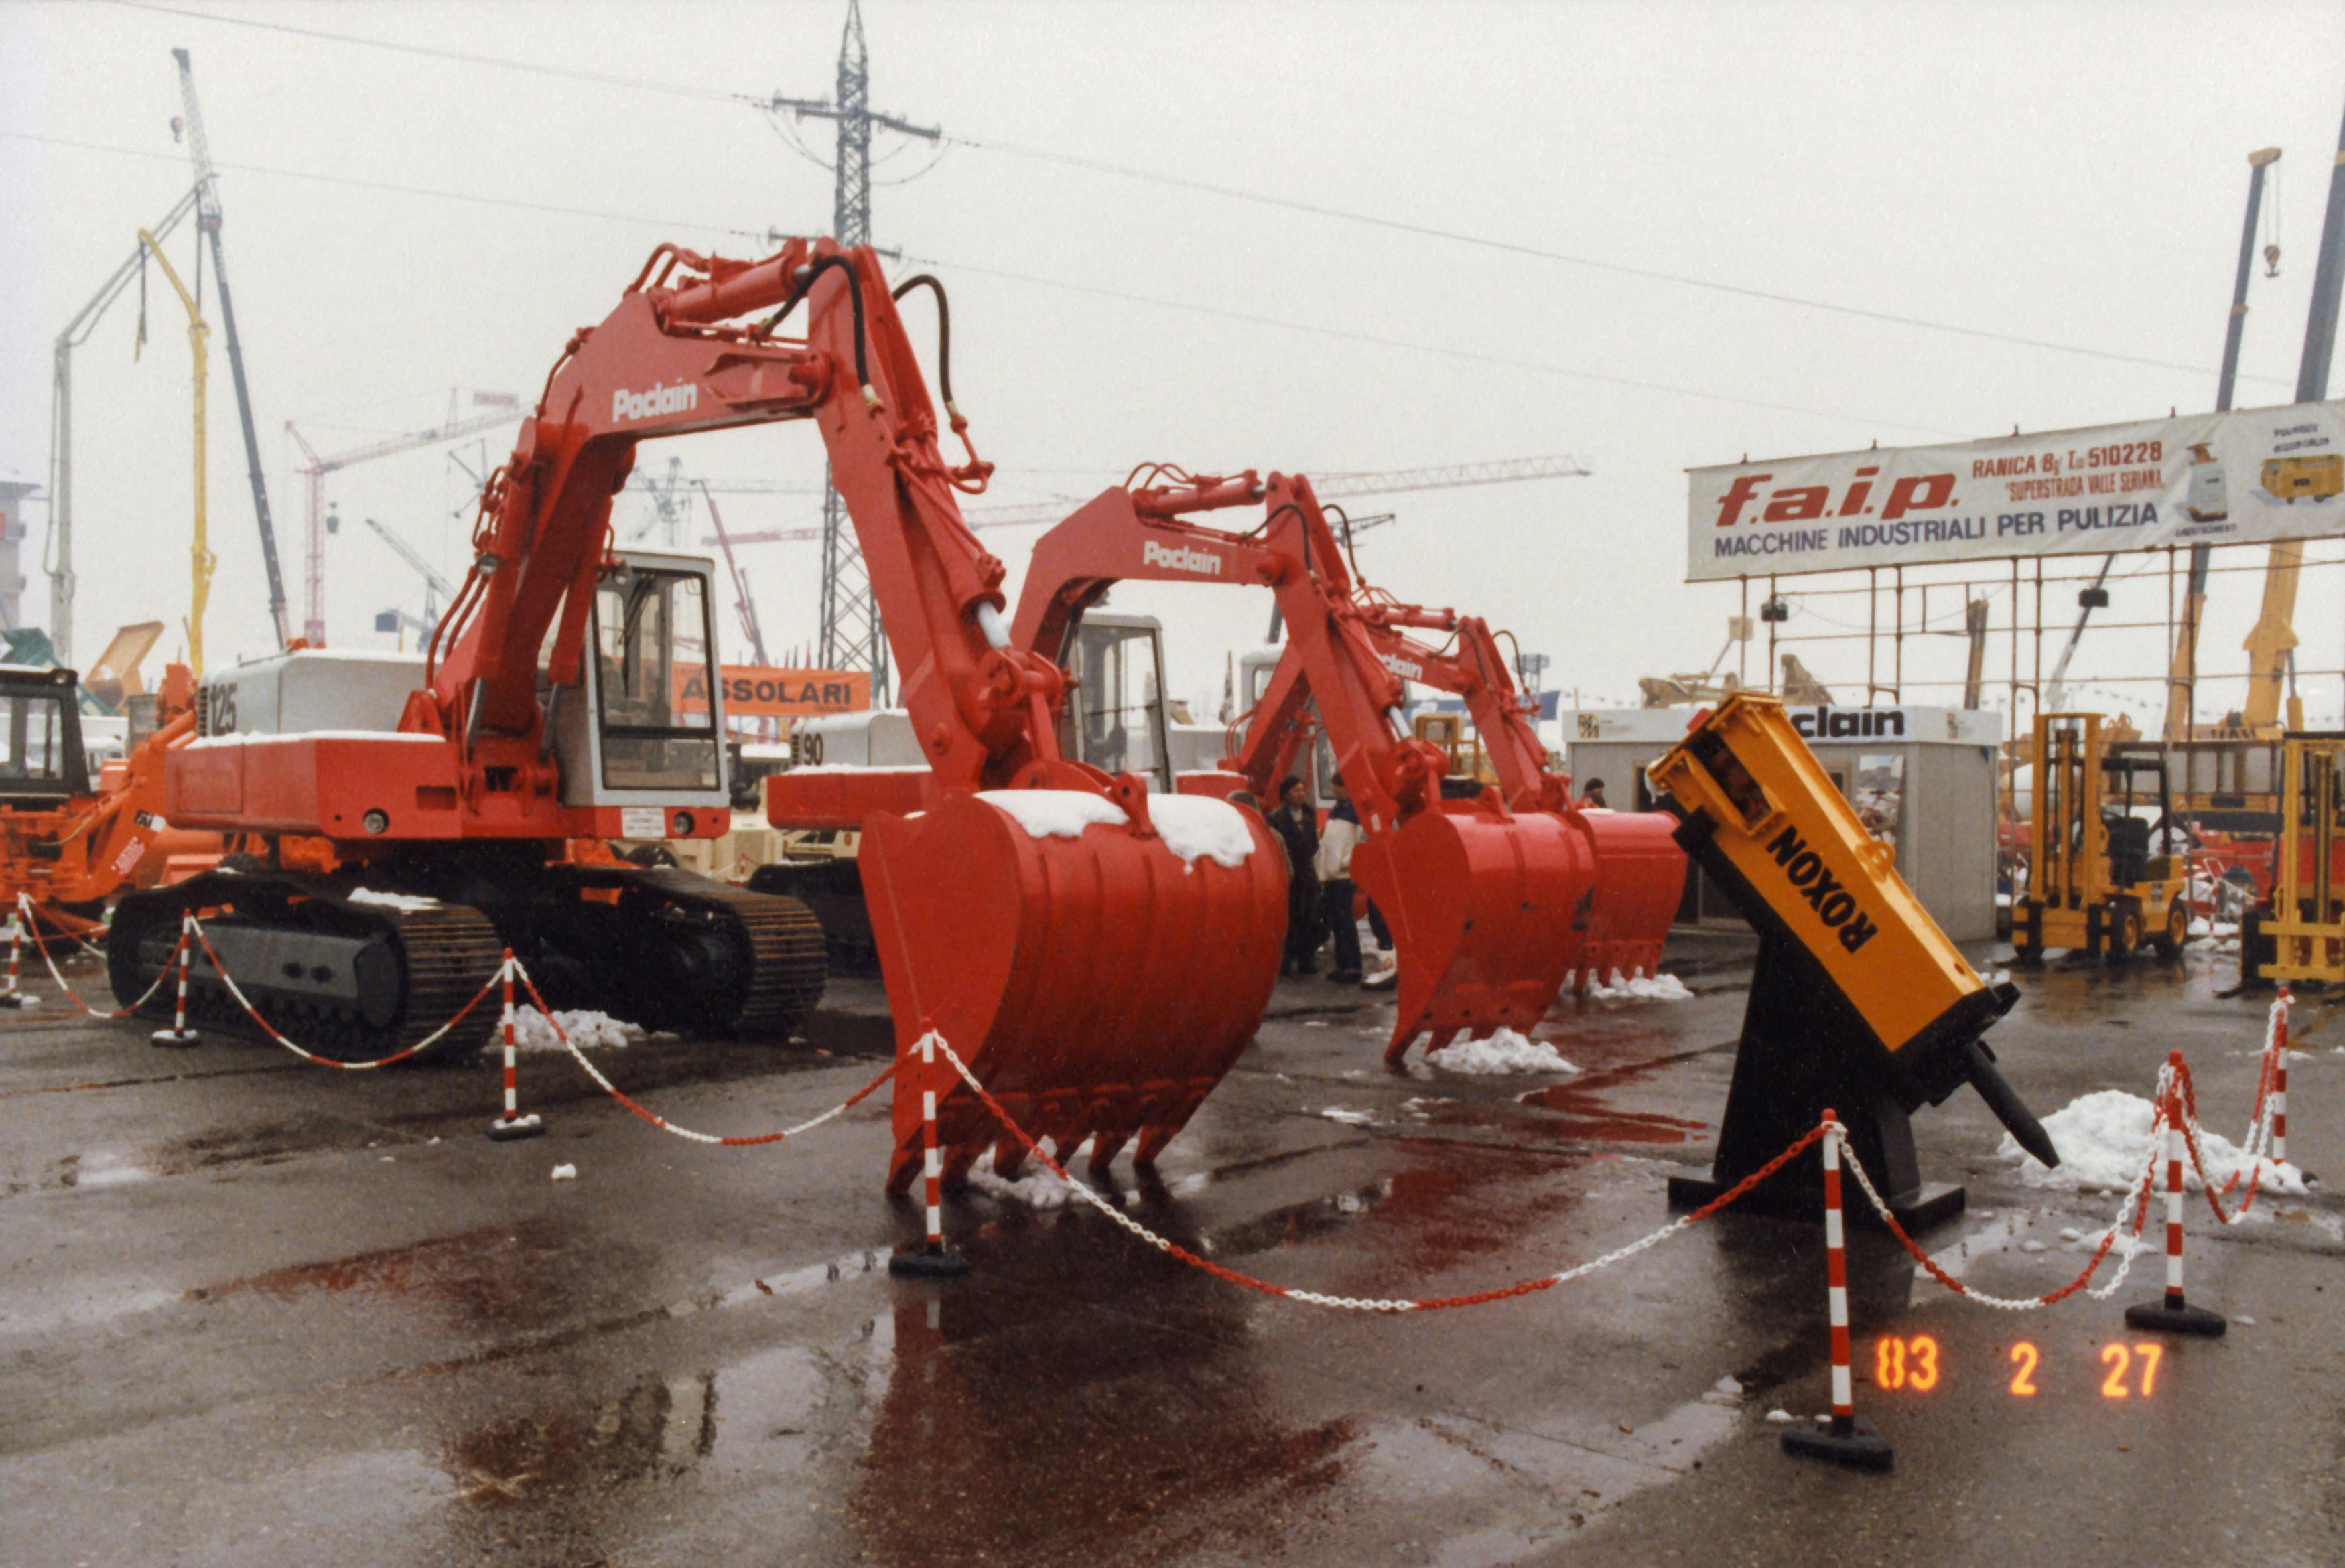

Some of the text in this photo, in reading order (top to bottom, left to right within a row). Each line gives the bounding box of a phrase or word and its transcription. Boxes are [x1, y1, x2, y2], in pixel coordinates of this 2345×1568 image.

[612, 377, 697, 423] Poclain
[1972, 455, 2036, 478] RANICA
[2088, 441, 2162, 468] 510228
[1715, 529, 1828, 557] MACCHINE
[1838, 516, 1985, 549] INDUSTRIALI
[1997, 511, 2045, 537] PER
[2058, 502, 2158, 532] PULIZIA
[1143, 540, 1221, 575] Poclain
[1376, 653, 1422, 681] clain
[210, 681, 237, 737] 125
[1790, 705, 1904, 738] clain
[804, 733, 823, 766] 90
[1766, 825, 1878, 954] ROXON
